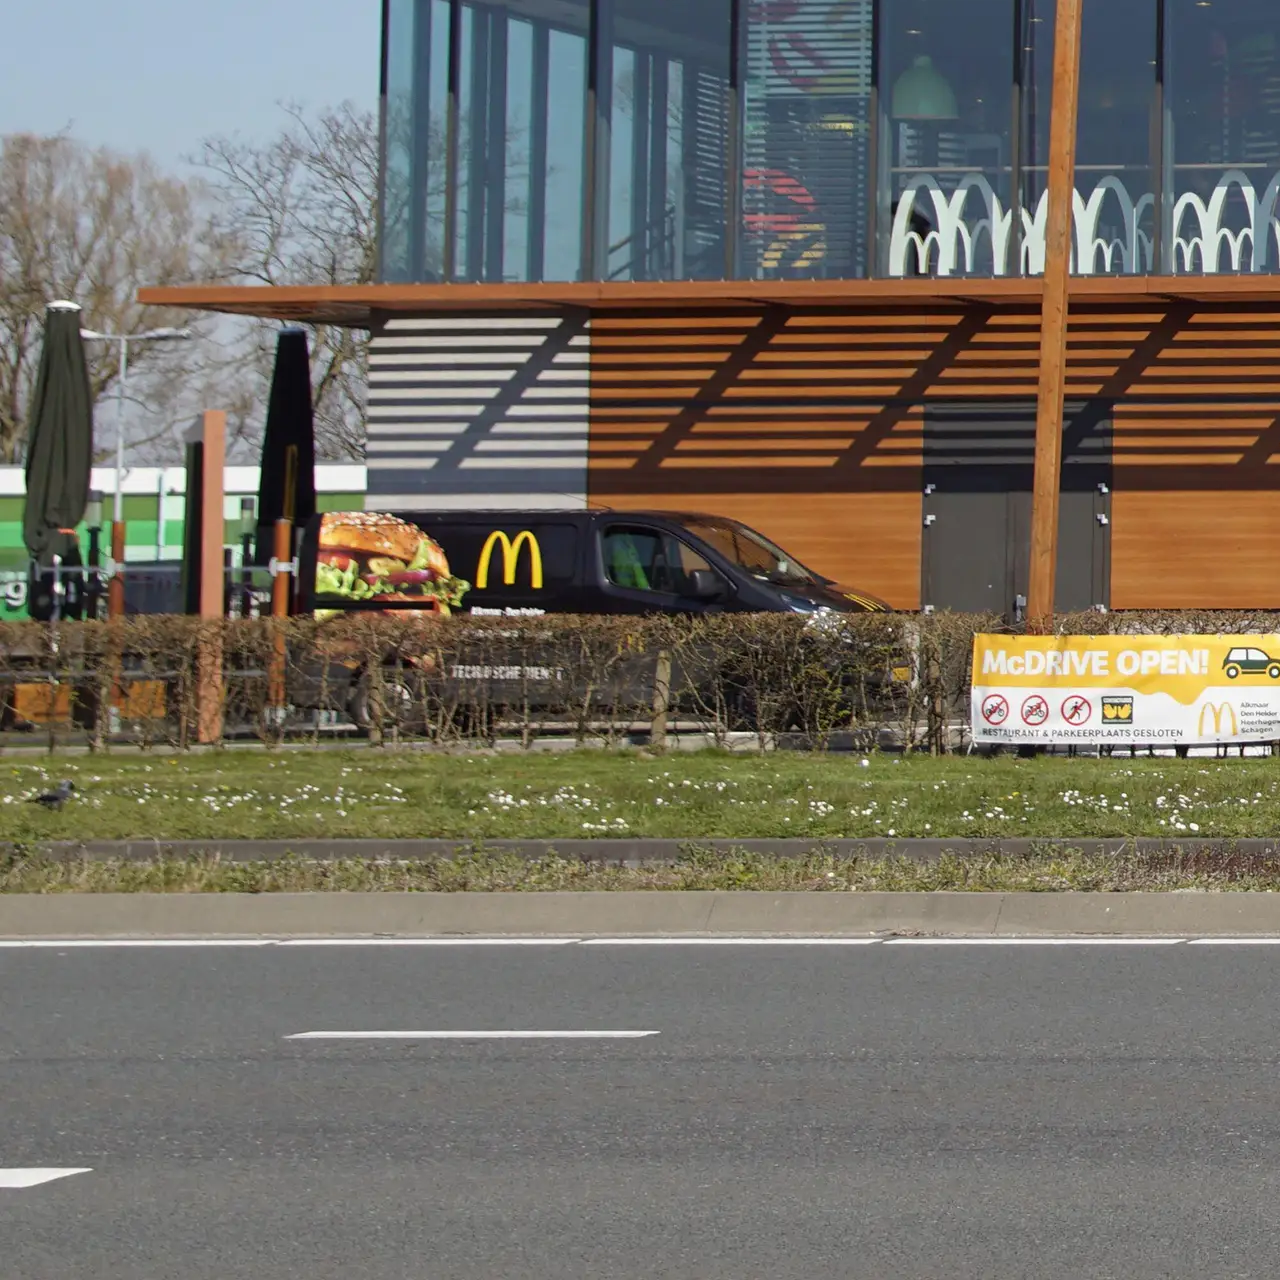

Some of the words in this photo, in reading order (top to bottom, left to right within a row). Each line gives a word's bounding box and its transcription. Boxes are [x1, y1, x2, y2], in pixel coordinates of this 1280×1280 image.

[983, 650, 1109, 676] McDRIVE
[1116, 649, 1210, 676] OPEN!
[982, 728, 1041, 738] RESTAURANT
[1042, 729, 1049, 738] &
[1051, 728, 1131, 738] PARKEERPLAATS
[1133, 729, 1184, 738] GESLOTEN
[1240, 726, 1273, 734] Schagen
